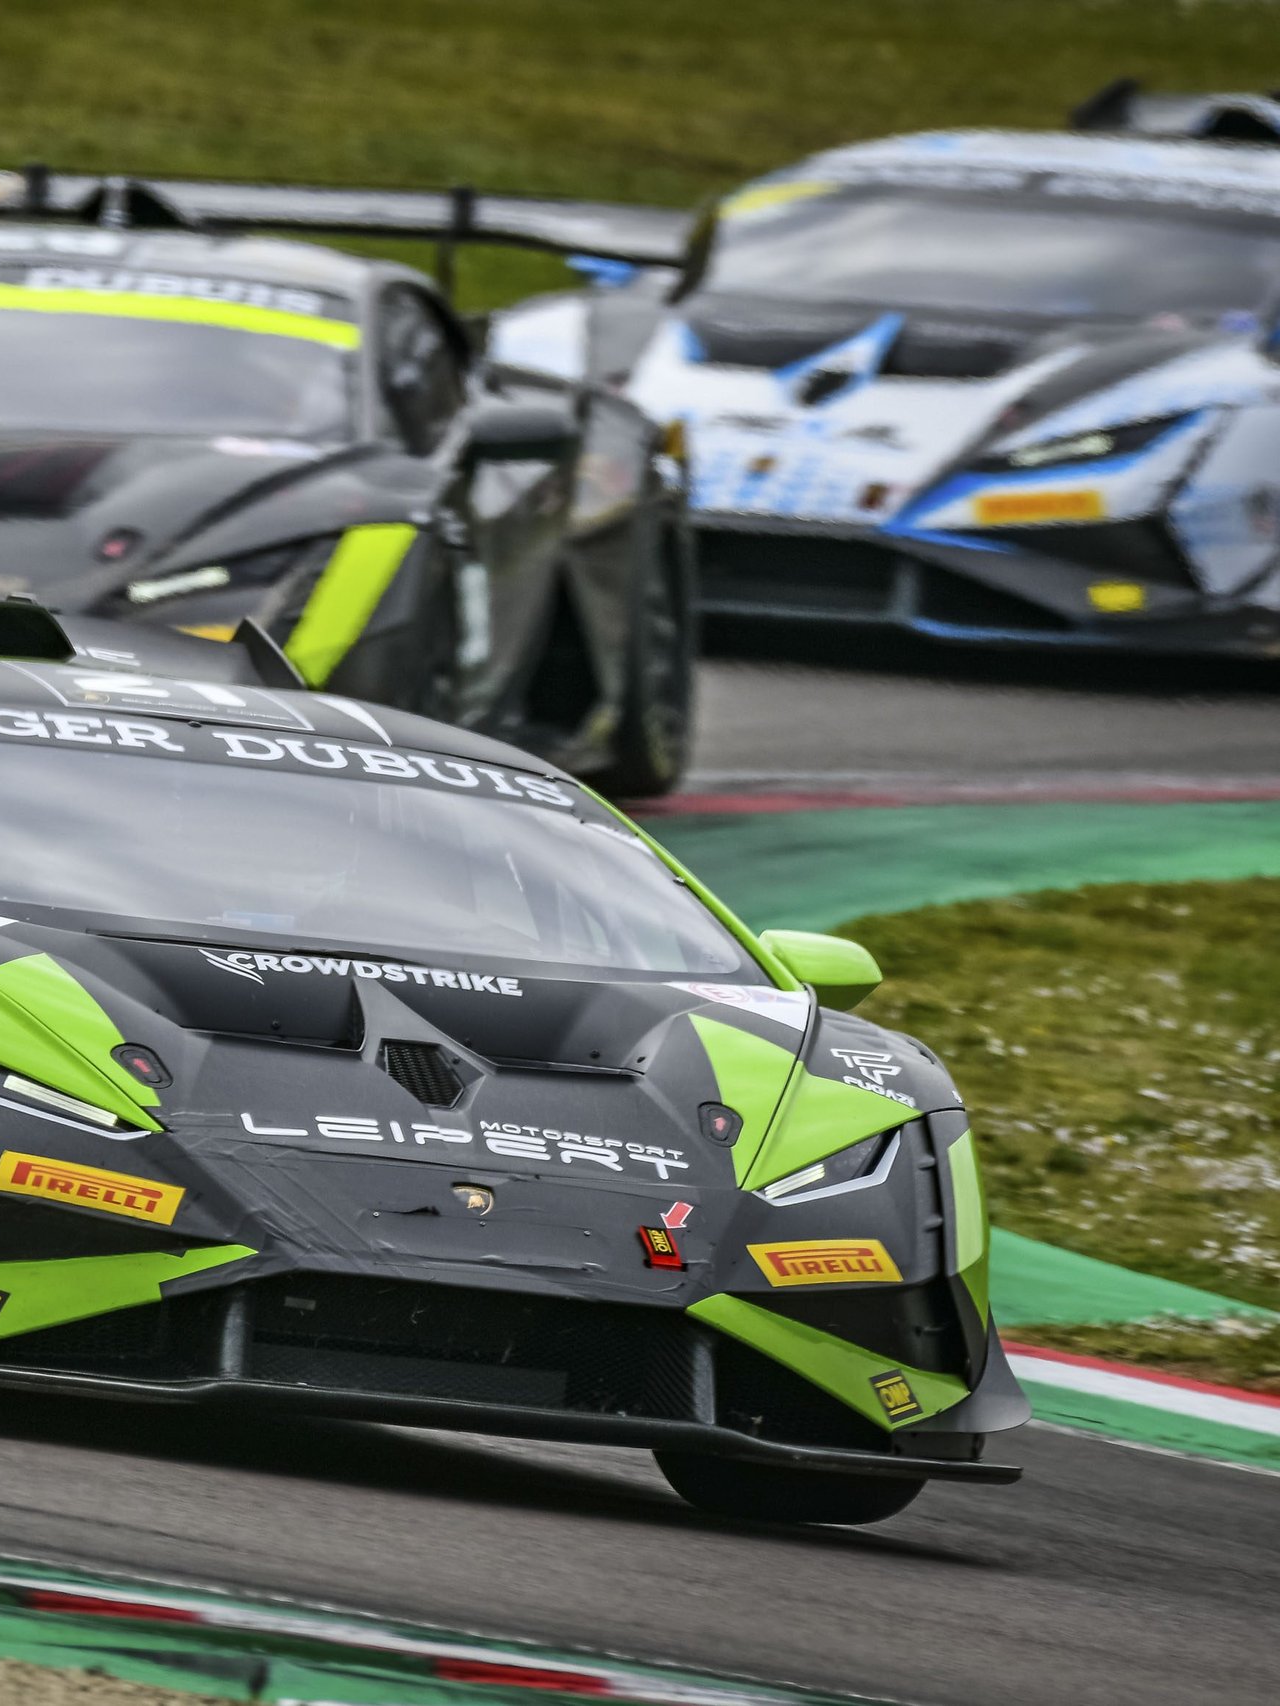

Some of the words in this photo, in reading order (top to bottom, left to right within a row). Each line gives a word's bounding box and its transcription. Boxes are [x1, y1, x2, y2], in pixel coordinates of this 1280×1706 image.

[212, 732, 575, 807] DUBUIS
[226, 952, 524, 997] CROWDSTRIKE
[842, 1075, 917, 1109] FUGAZI
[240, 1112, 690, 1181] LEIPERT
[480, 1120, 685, 1160] MOTORSPORT
[11, 1161, 163, 1214] PIRELLI
[651, 1230, 669, 1252] OMP
[765, 1248, 884, 1277] PIRELLI
[880, 1382, 910, 1409] OMP
